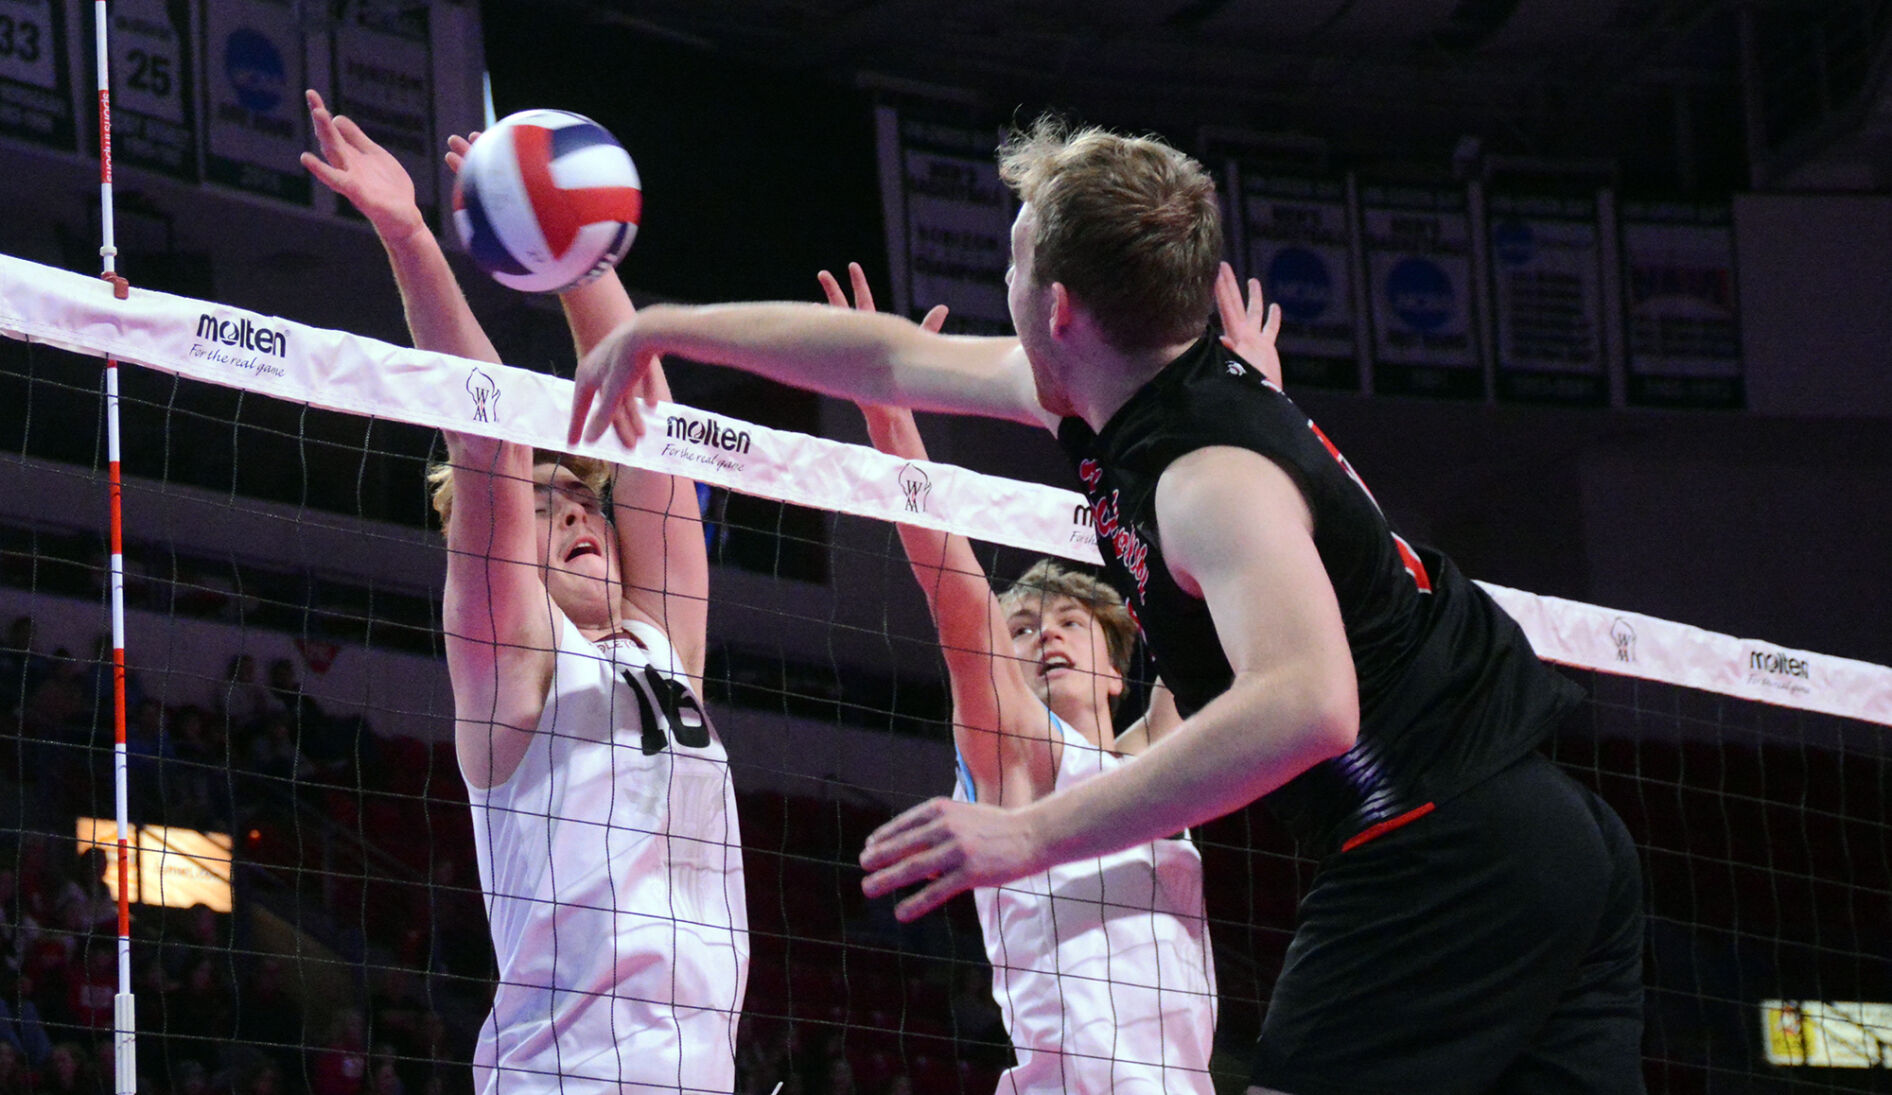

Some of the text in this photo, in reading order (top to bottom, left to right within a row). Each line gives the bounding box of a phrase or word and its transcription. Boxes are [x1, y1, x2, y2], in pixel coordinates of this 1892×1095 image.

[127, 48, 171, 96] 25
[197, 313, 286, 358] molten
[189, 344, 285, 377] For the real game
[661, 443, 679, 456] For
[696, 454, 719, 465] real
[667, 416, 751, 454] molten
[1750, 651, 1808, 679] molten
[621, 663, 711, 756] 16
